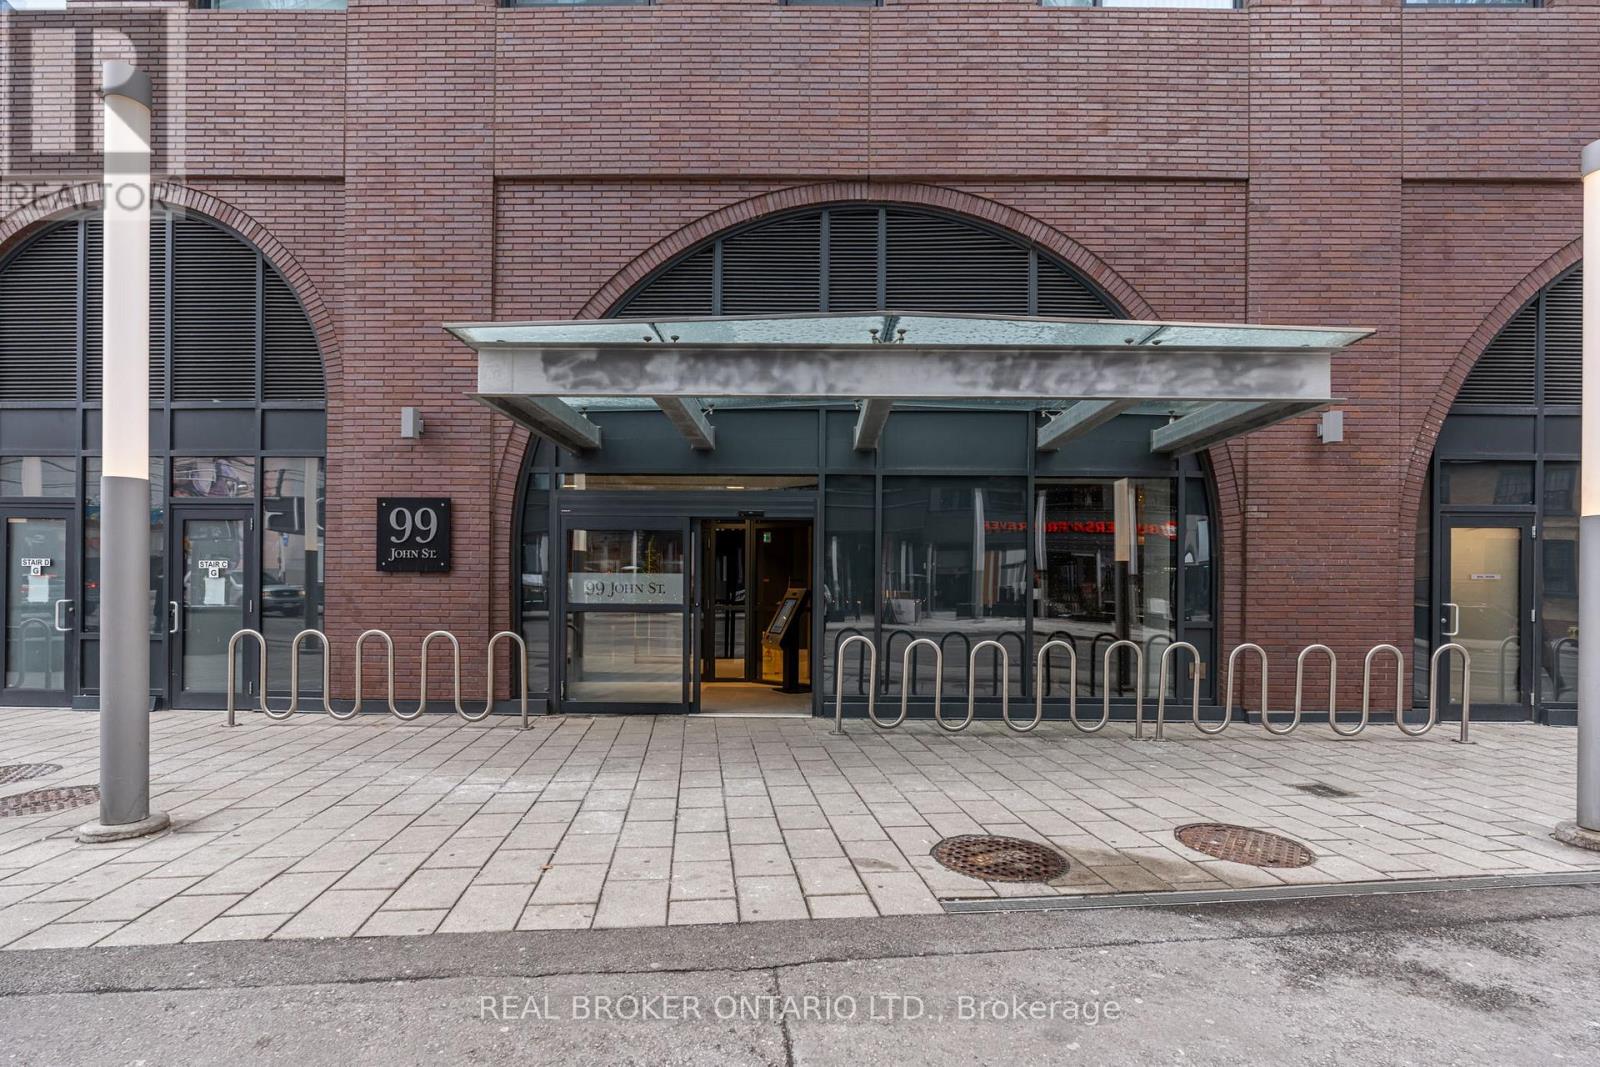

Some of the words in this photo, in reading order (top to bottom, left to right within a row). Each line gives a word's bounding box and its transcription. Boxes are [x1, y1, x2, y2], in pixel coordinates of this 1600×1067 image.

[389, 507, 438, 543] 99
[388, 548, 419, 561] JOHN
[32, 567, 40, 575] G
[210, 569, 217, 577] G
[586, 581, 605, 596] 99
[608, 581, 645, 597] JOHN
